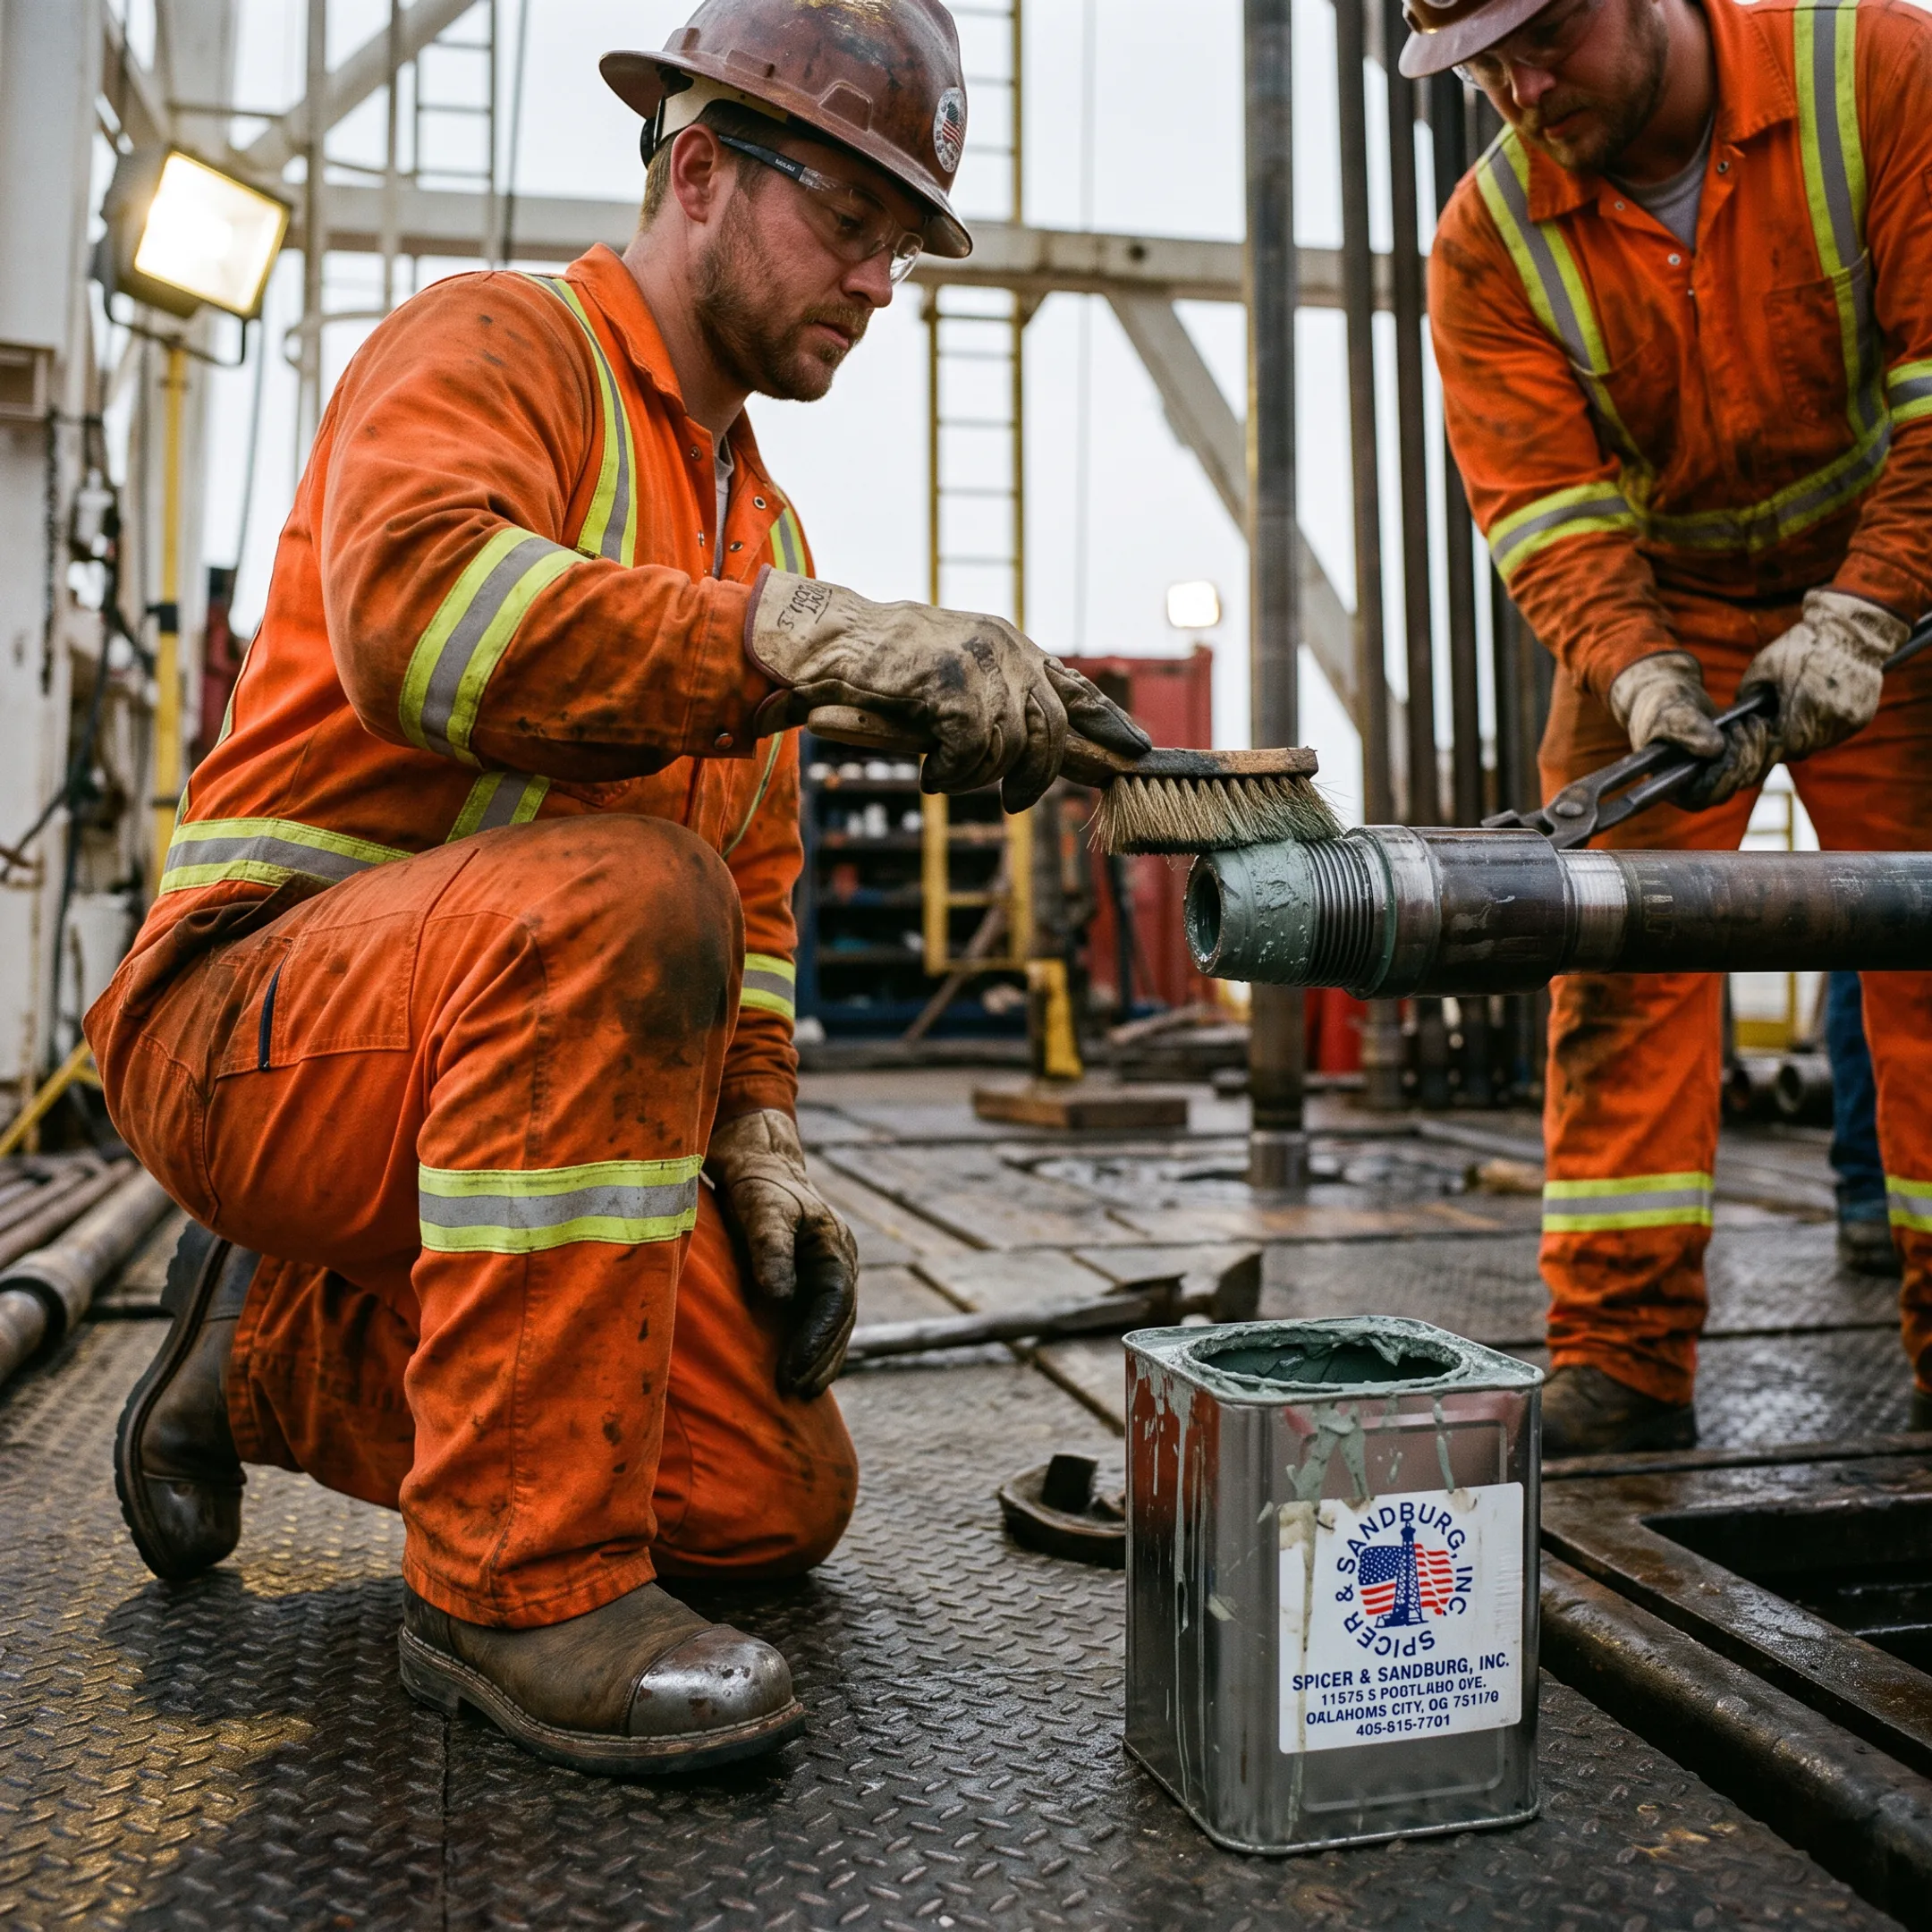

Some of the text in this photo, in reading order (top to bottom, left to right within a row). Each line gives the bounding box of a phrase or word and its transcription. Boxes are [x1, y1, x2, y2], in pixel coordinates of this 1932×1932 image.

[1336, 1502, 1466, 1574] SANDBURG,
[1335, 1583, 1354, 1602] &
[1343, 1611, 1436, 1658] SPICER
[1292, 1652, 1510, 1691] SPICER & SANDBURG, INC.
[1321, 1690, 1364, 1707] 11575
[1368, 1688, 1377, 1701] S
[1391, 1699, 1425, 1716] CITY,
[1428, 1697, 1449, 1712] OG
